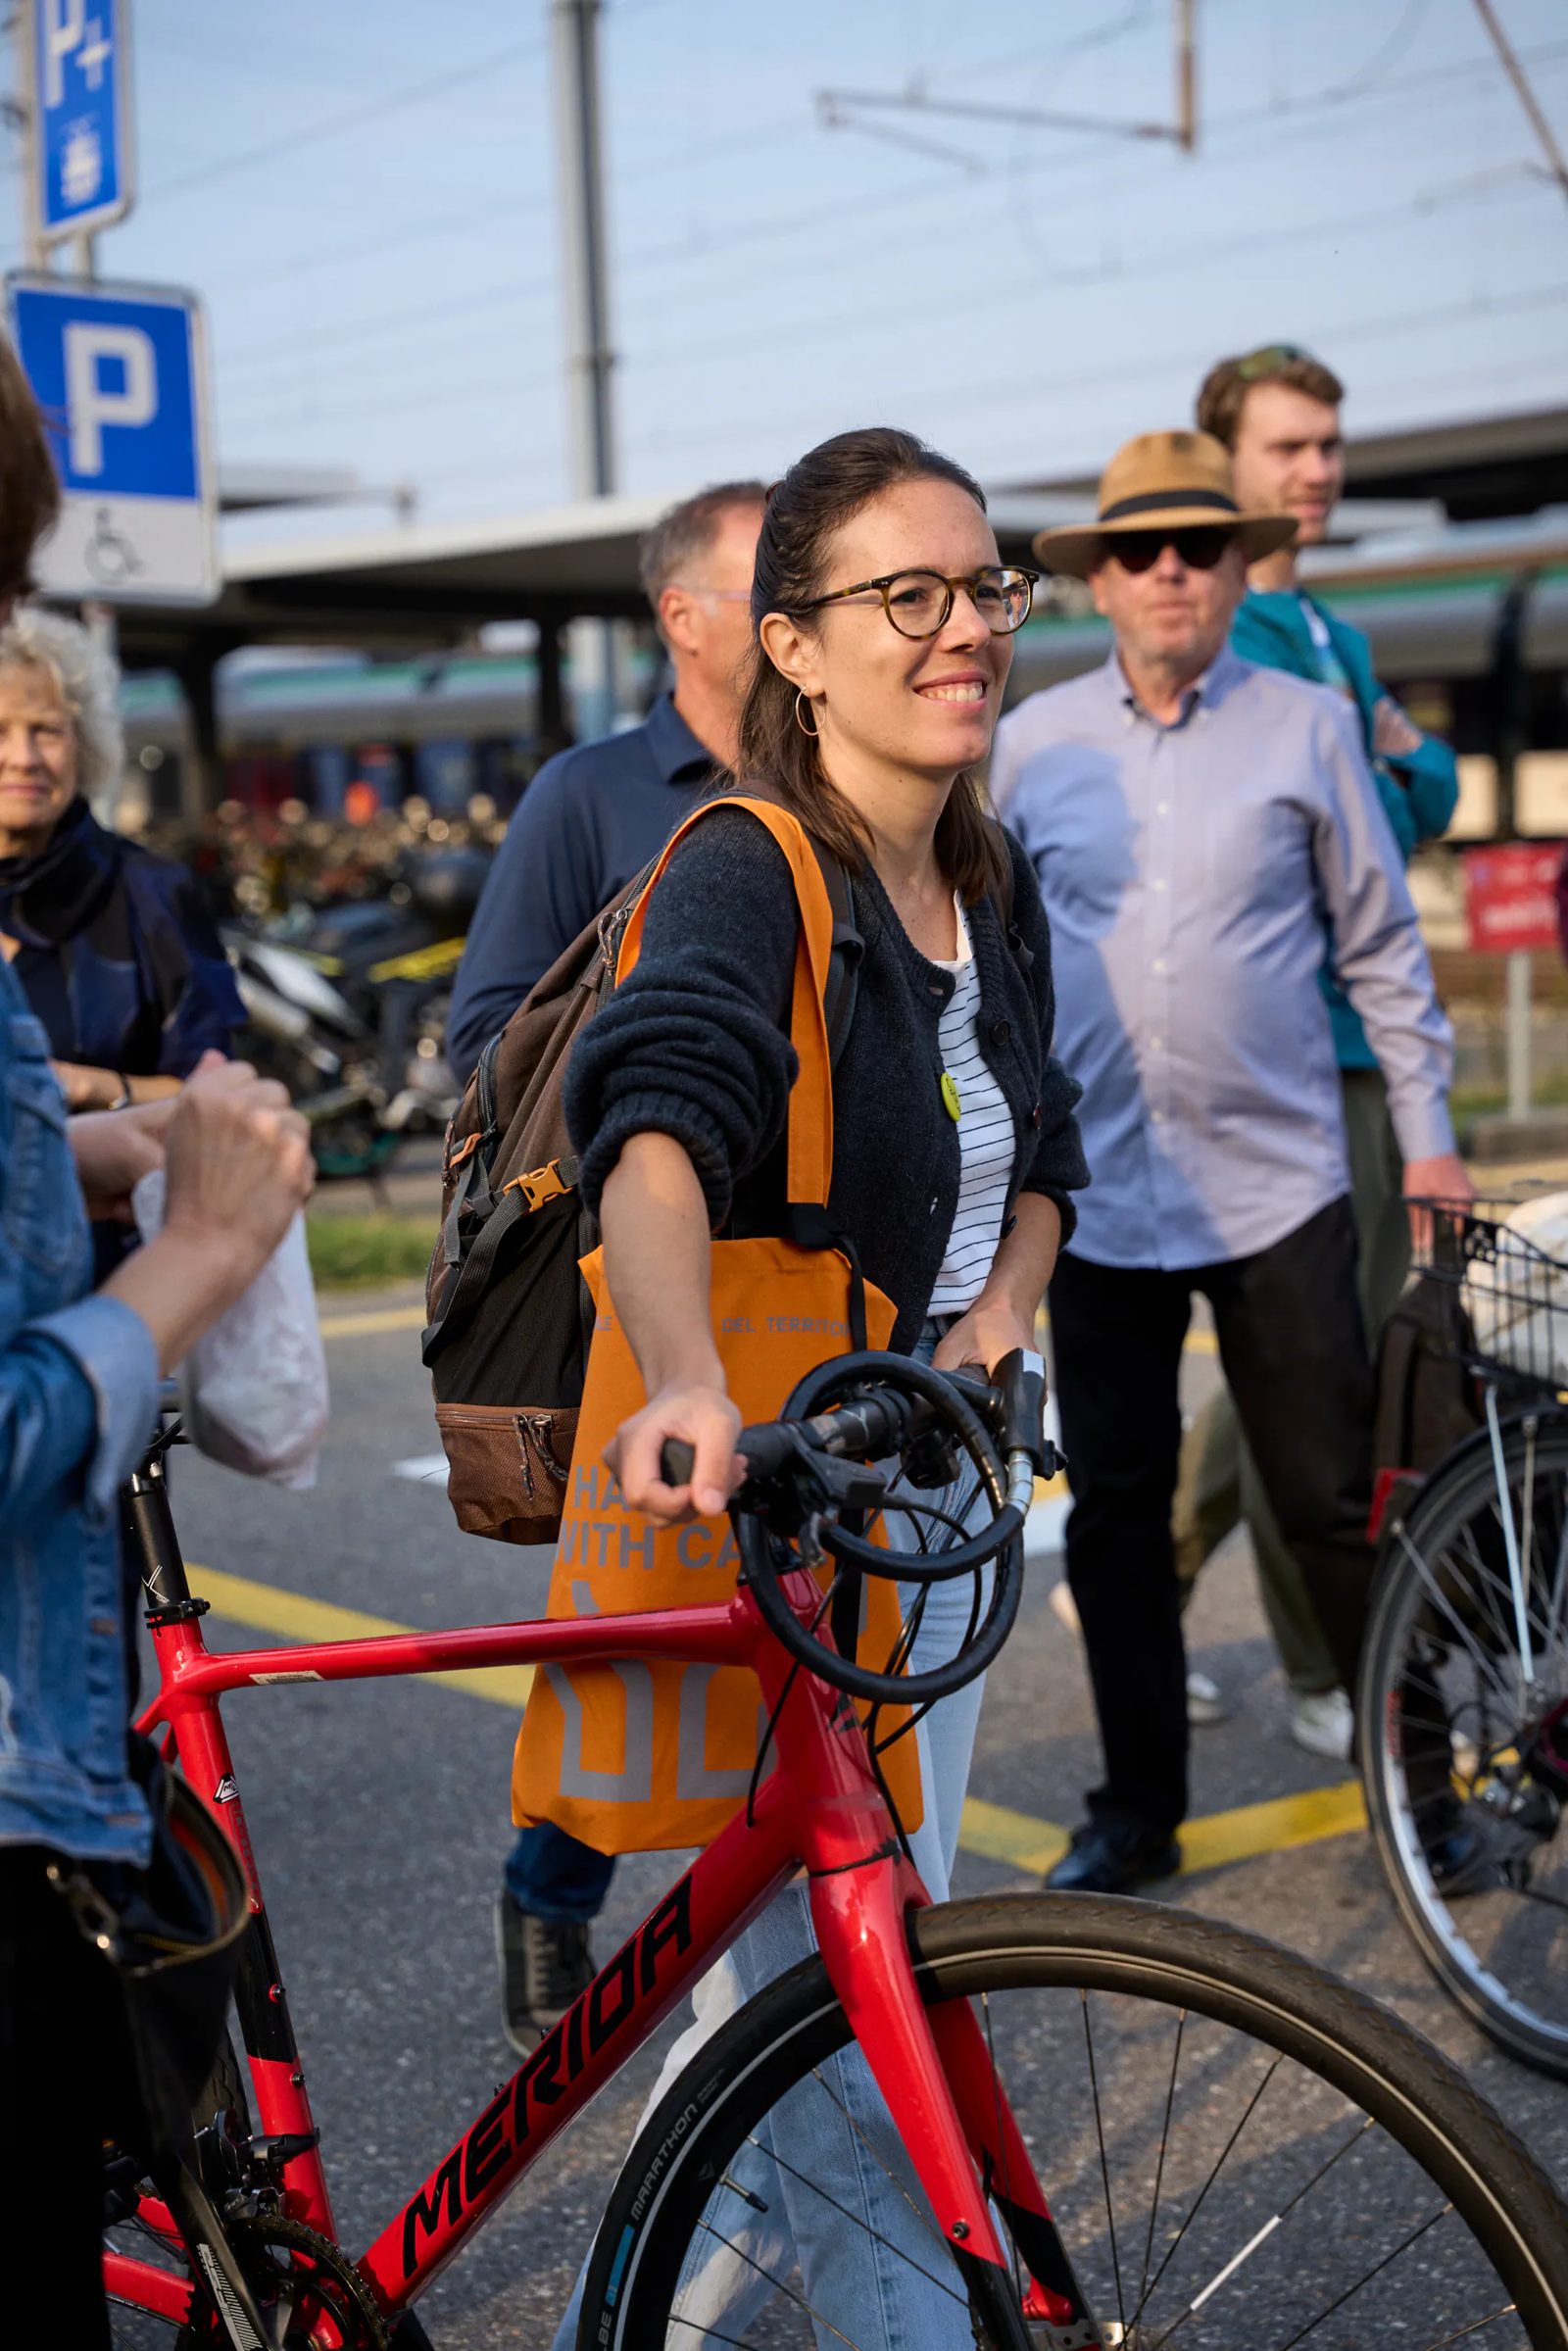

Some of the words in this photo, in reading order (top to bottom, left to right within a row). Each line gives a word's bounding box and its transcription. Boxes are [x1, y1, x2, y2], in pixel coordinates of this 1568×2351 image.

[64, 321, 157, 476] P
[722, 1317, 756, 1333] DEL
[402, 1874, 693, 2280] MERIDA
[630, 2103, 698, 2221] MARATHON
[598, 2310, 612, 2351] BE
